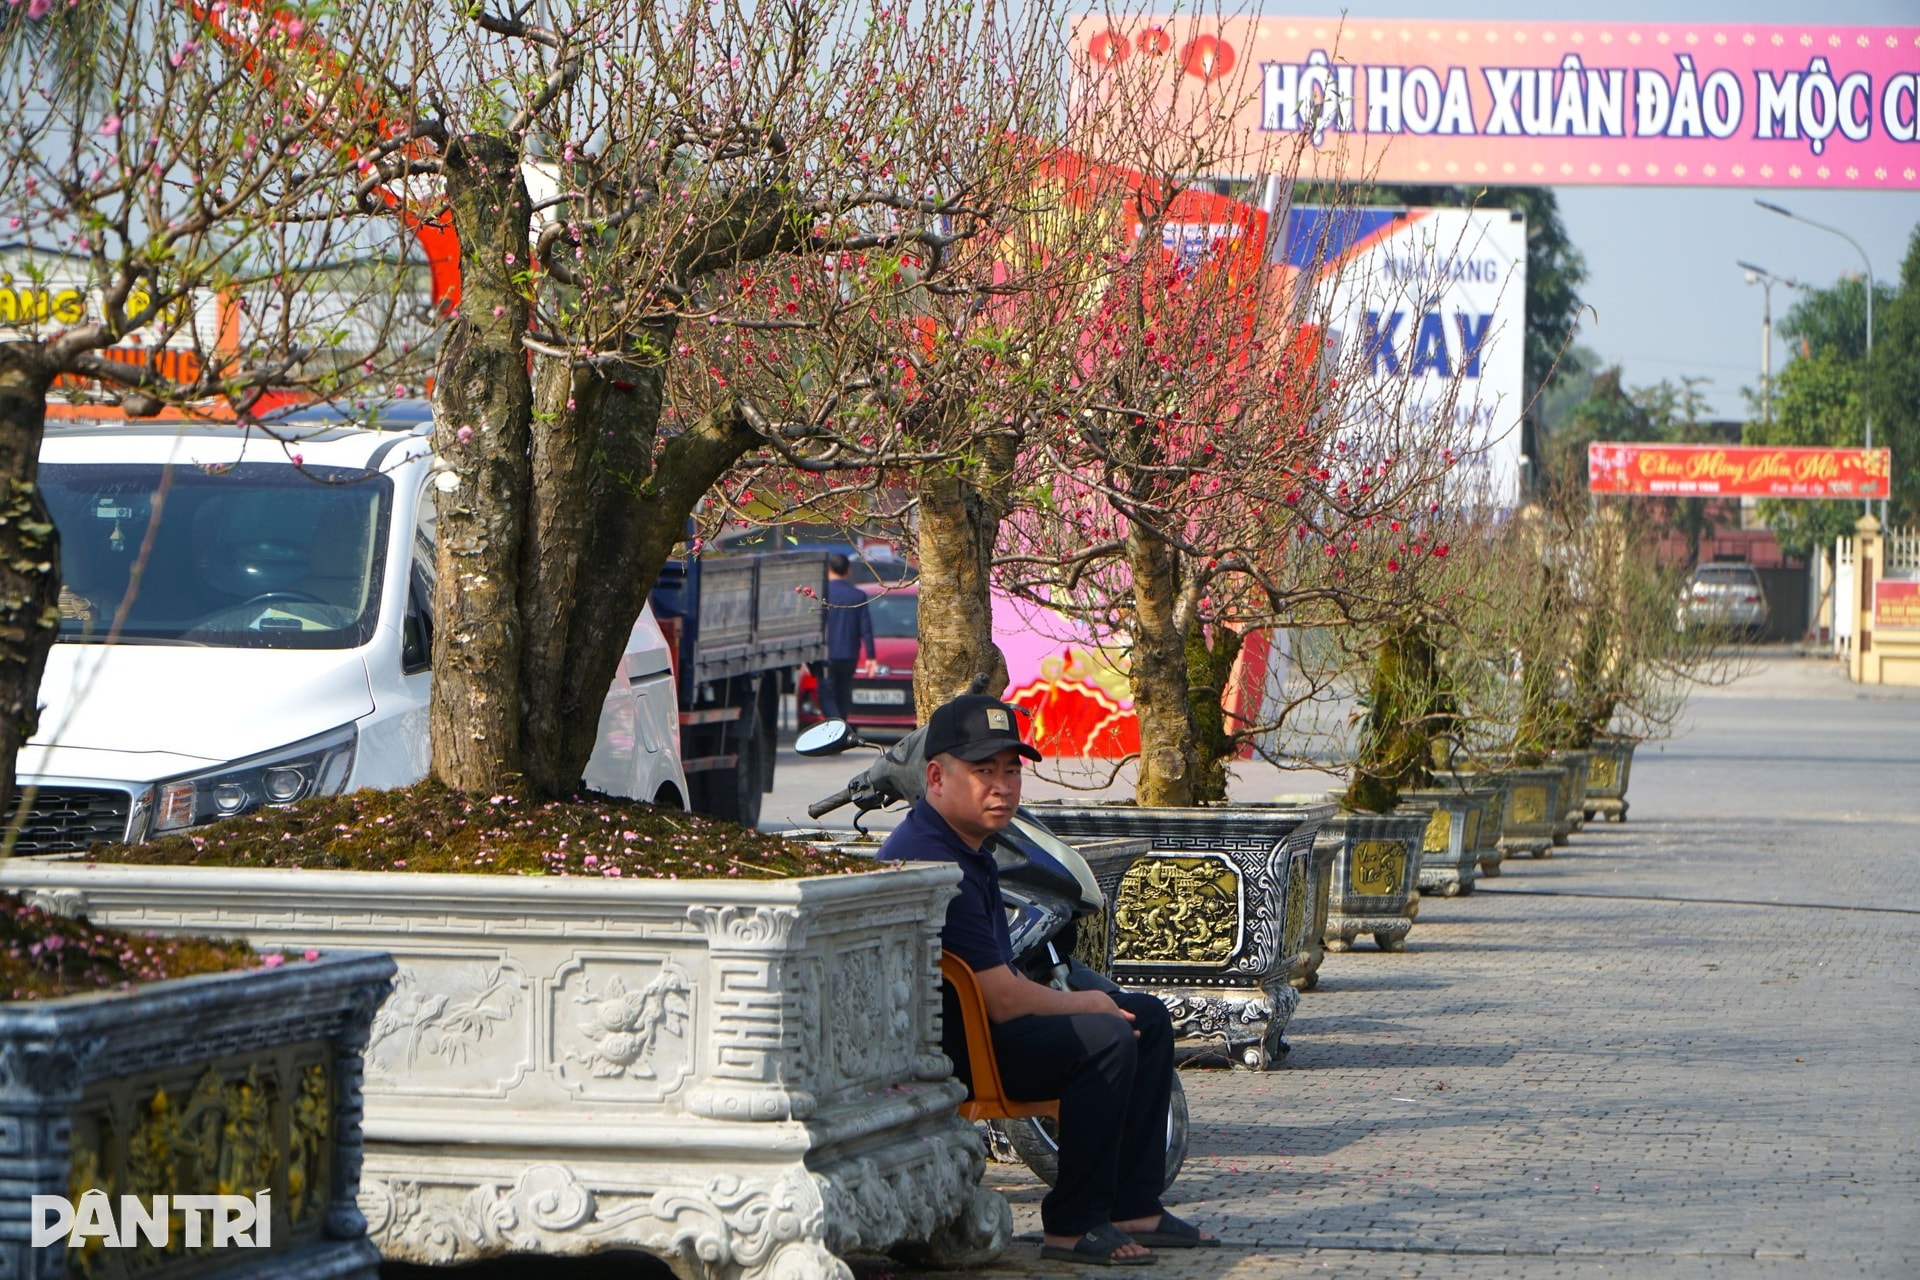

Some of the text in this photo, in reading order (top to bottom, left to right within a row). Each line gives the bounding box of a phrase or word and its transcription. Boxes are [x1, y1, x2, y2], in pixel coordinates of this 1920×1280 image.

[1259, 48, 1920, 156] HỘI HOA XUÂN ĐÀO MỘC C
